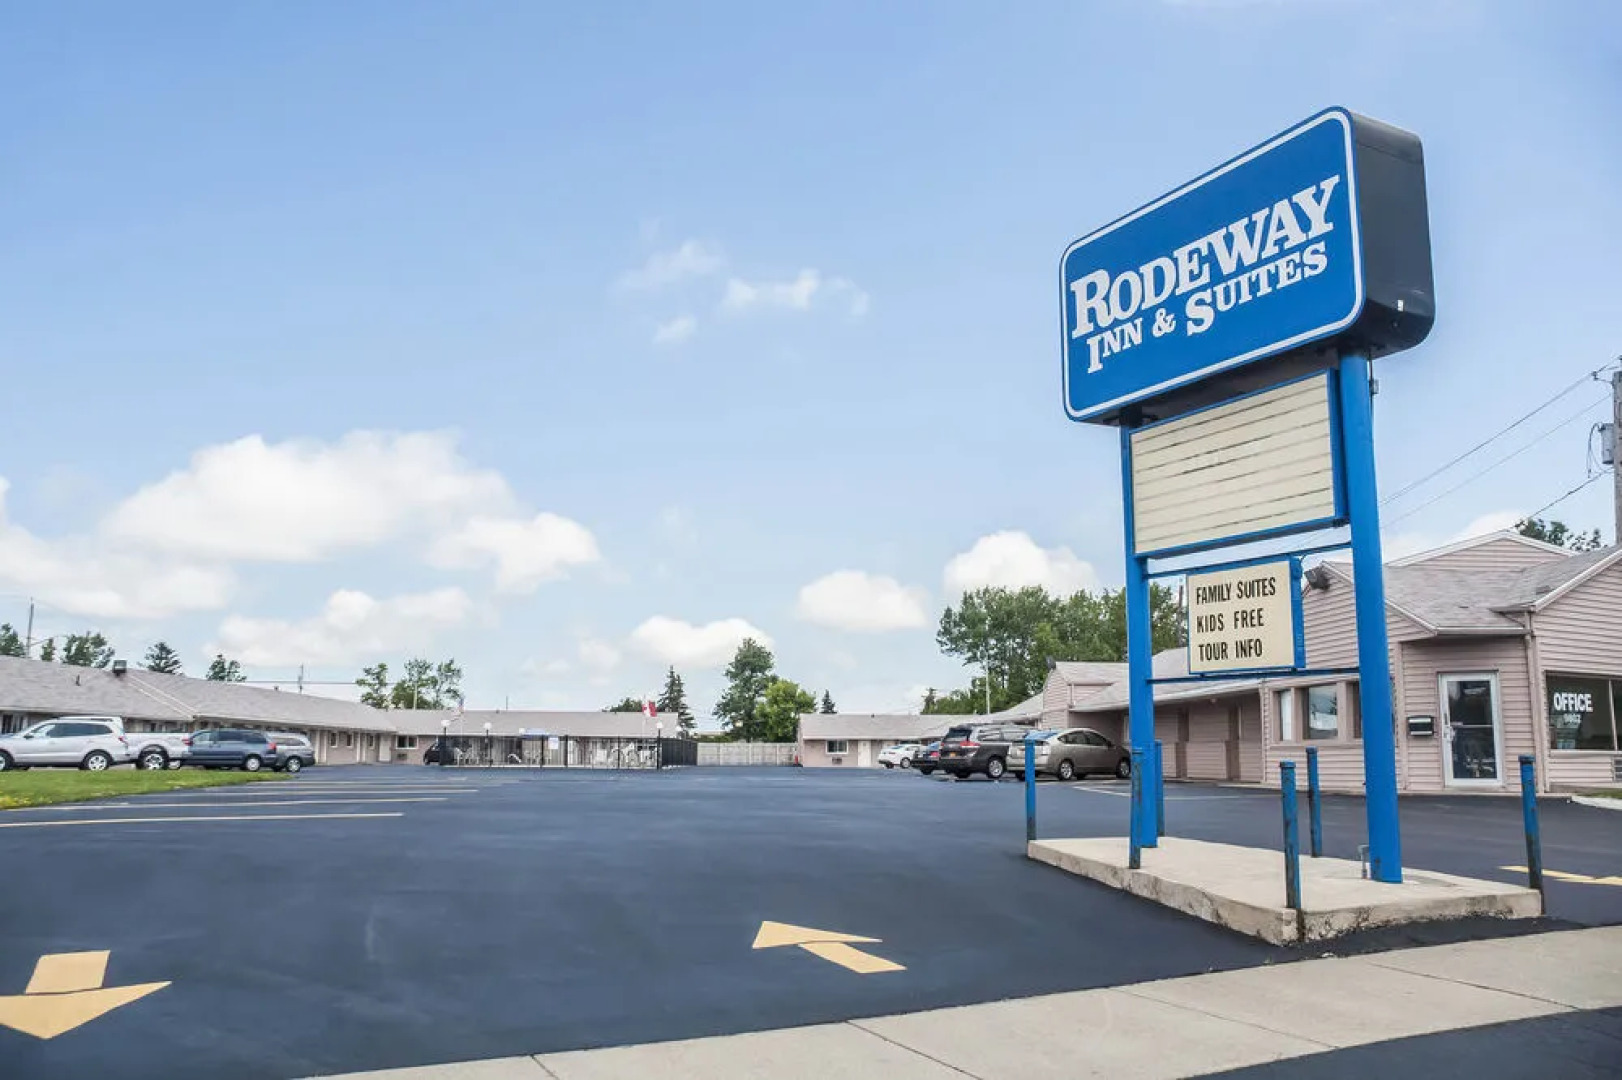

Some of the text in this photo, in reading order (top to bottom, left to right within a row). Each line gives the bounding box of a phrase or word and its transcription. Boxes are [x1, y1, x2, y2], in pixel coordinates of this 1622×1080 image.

[1070, 175, 1340, 339] RODEWAY
[1086, 241, 1328, 374] INN & SUITES
[1196, 577, 1276, 605] FAMILY SUITES
[1197, 608, 1264, 633] KIDS FREE
[1198, 639, 1262, 661] TOUR INFO
[1554, 692, 1593, 712] OFFICE
